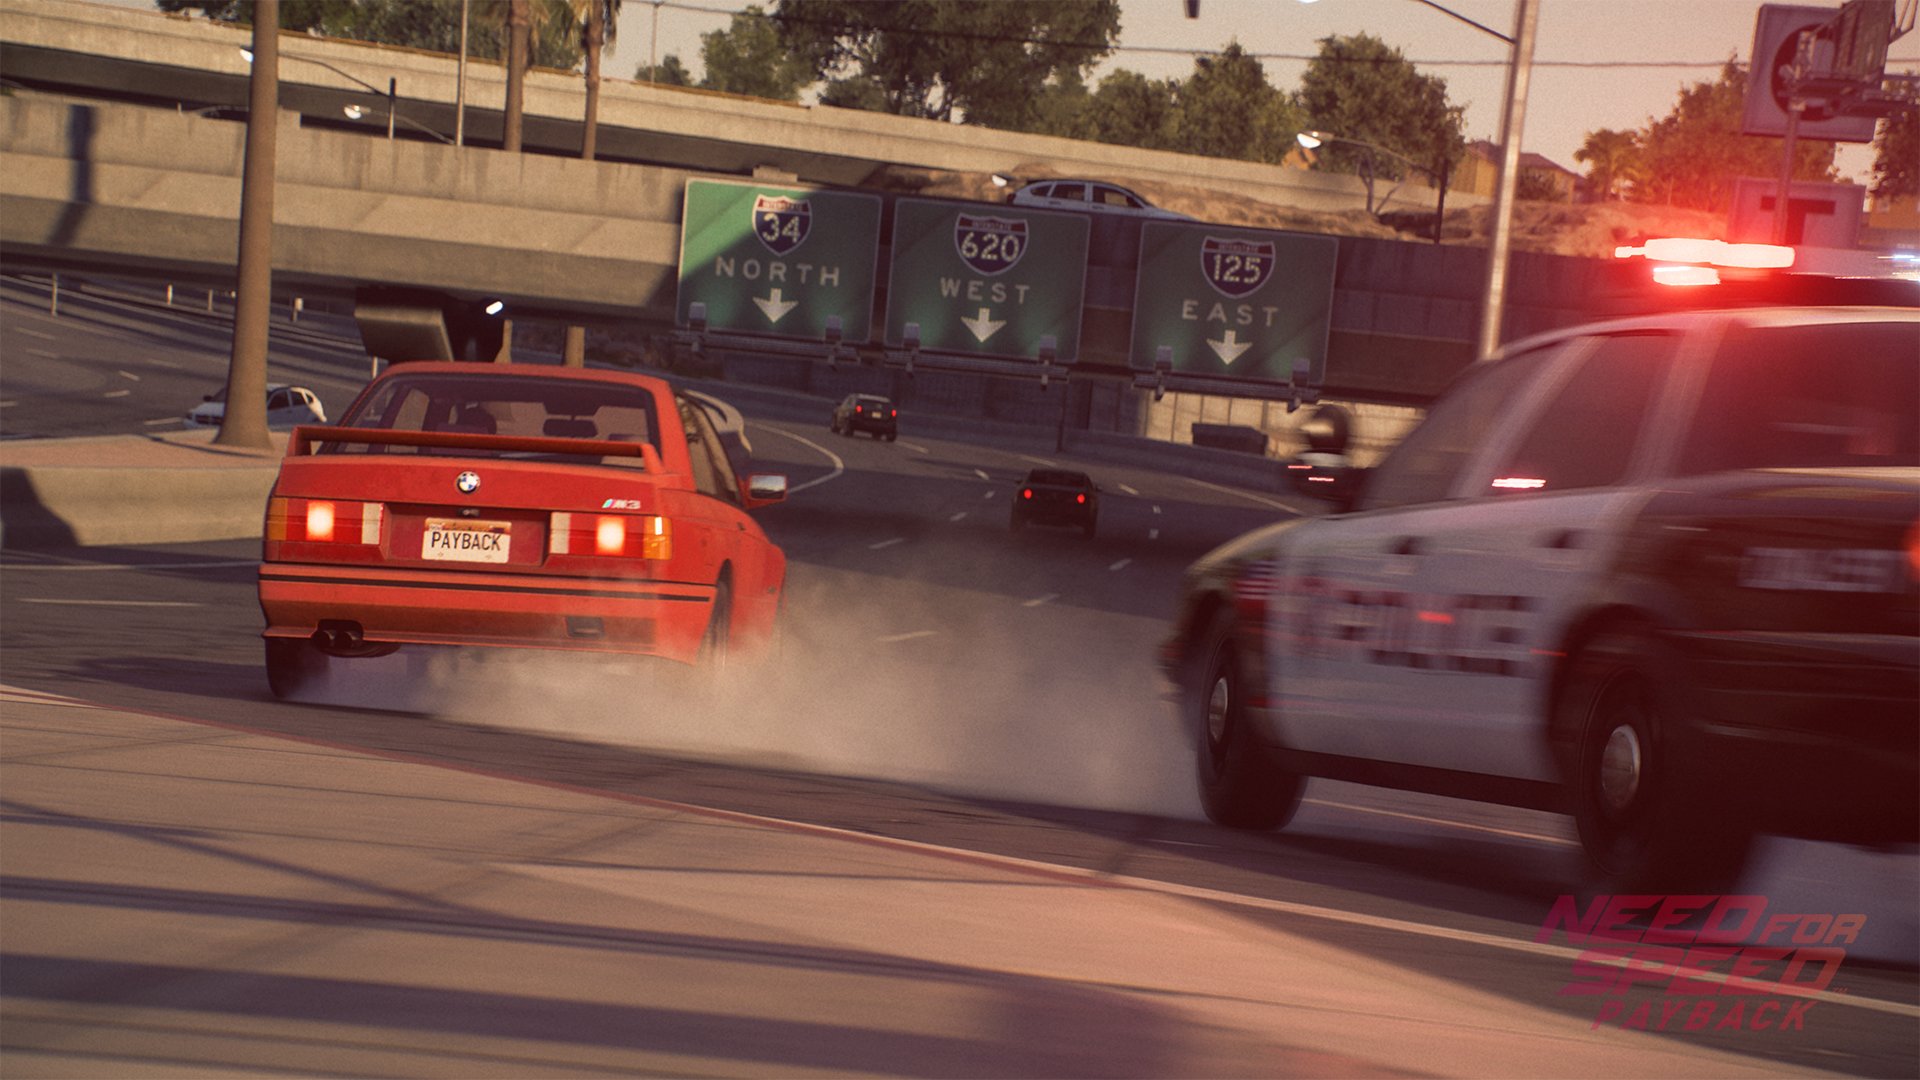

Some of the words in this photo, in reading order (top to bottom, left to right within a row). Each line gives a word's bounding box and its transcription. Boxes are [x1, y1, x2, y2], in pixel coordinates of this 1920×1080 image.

[762, 212, 801, 243] 34
[960, 231, 1020, 262] 620
[715, 255, 840, 287] NORTH
[1213, 253, 1261, 283] 125
[939, 276, 1030, 304] WEST
[1181, 299, 1279, 327] EAST
[610, 498, 641, 510] M3
[431, 531, 502, 551] PAYBACK
